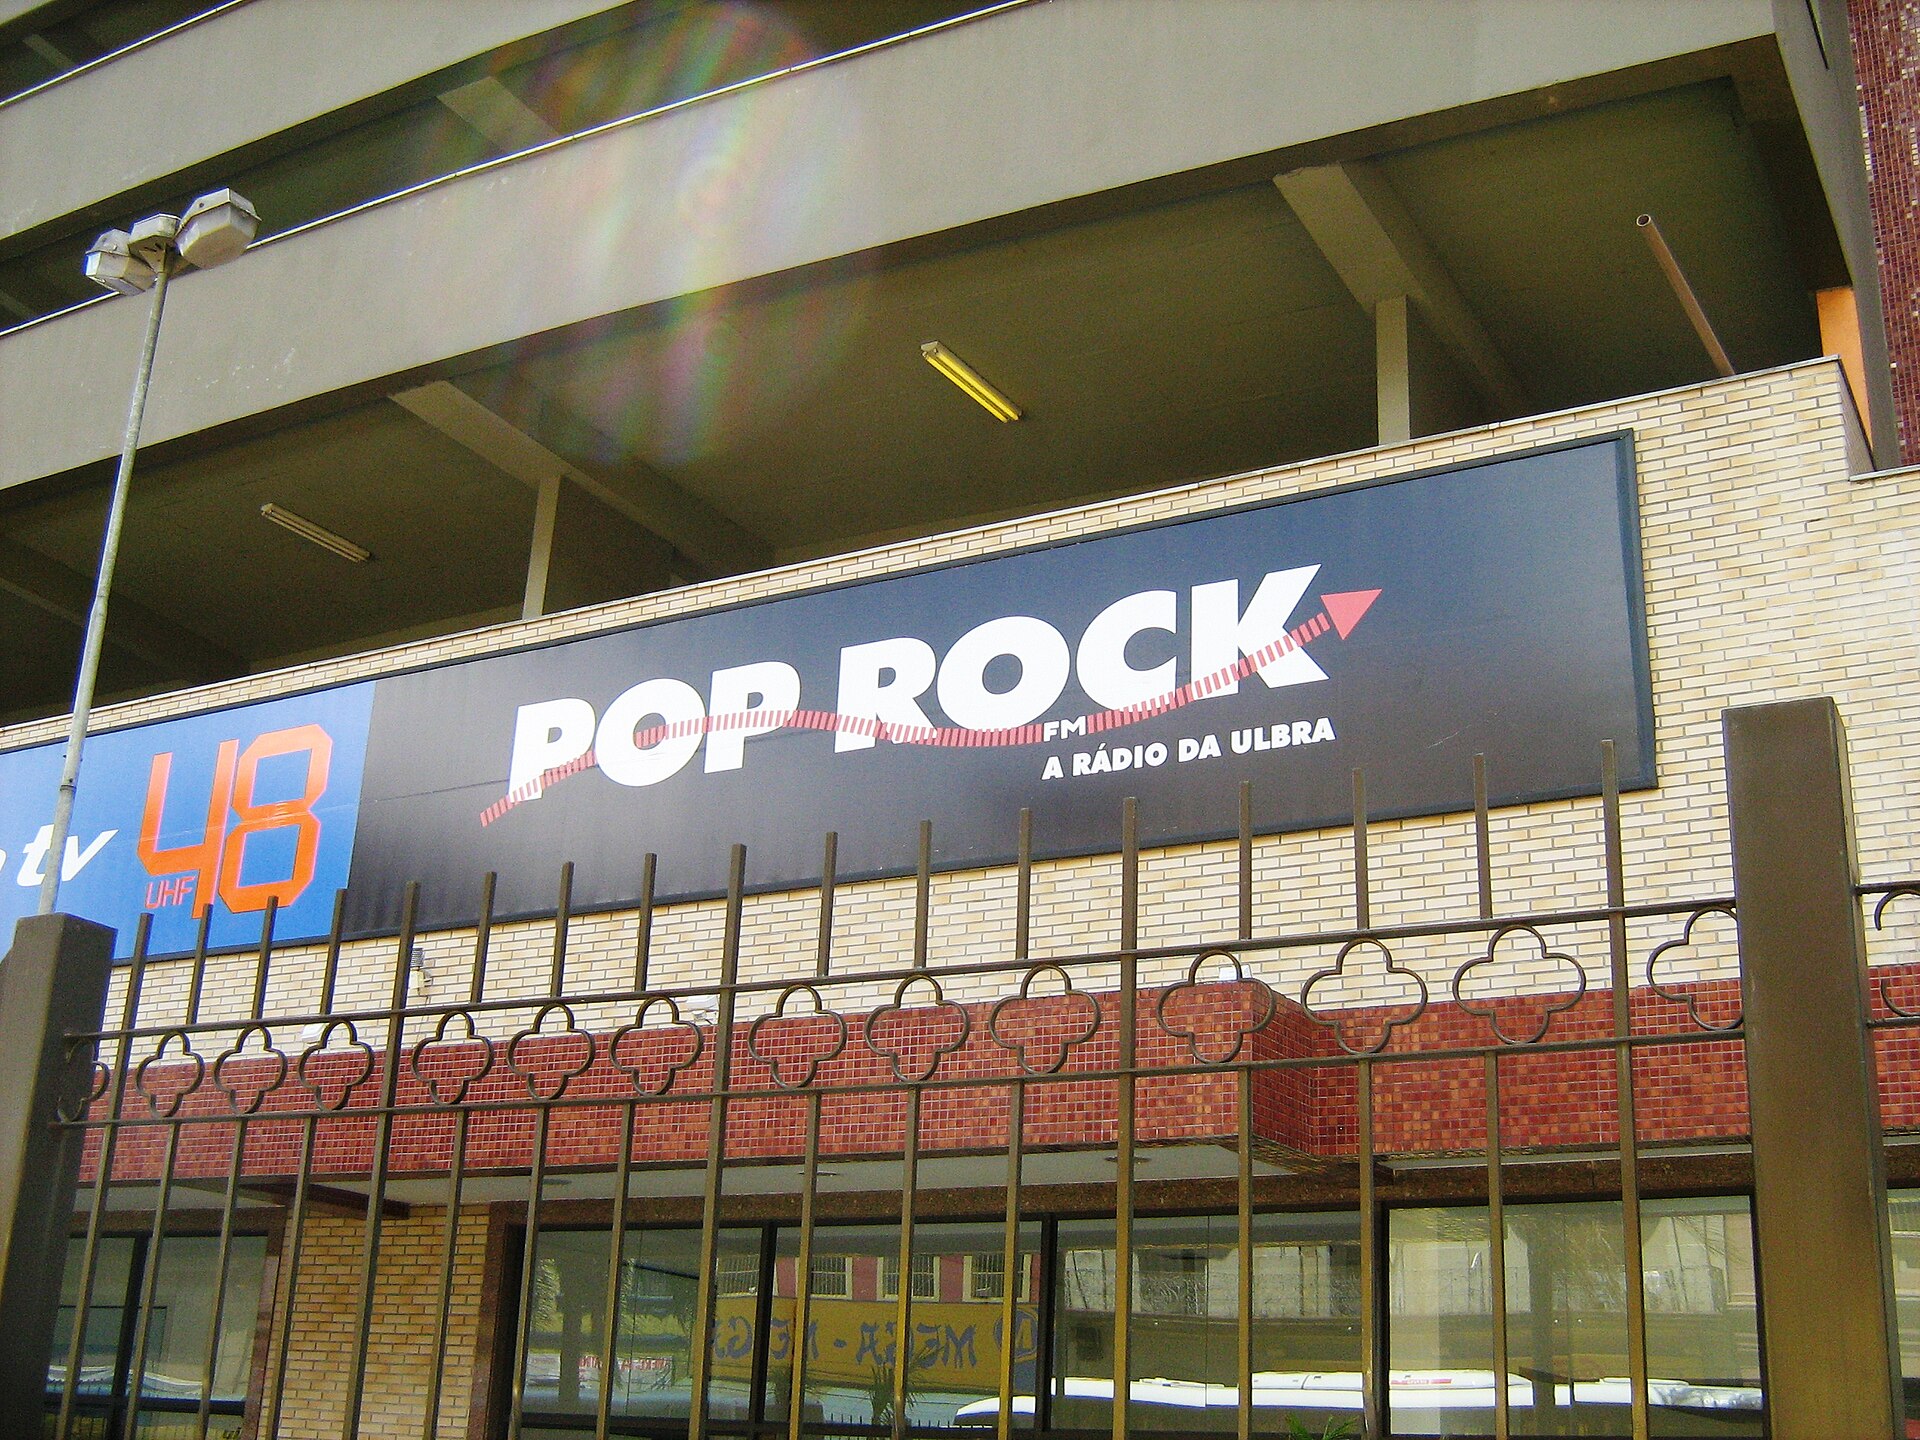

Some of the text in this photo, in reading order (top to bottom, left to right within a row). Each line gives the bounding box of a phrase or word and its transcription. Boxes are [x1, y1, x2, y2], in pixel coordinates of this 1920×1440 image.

[508, 564, 1330, 801] POP ROCK
[1041, 717, 1336, 780] A RÁDIO DA ULBRA
[1043, 715, 1087, 742] FM
[137, 724, 333, 919] 48
[145, 875, 196, 909] UHF
